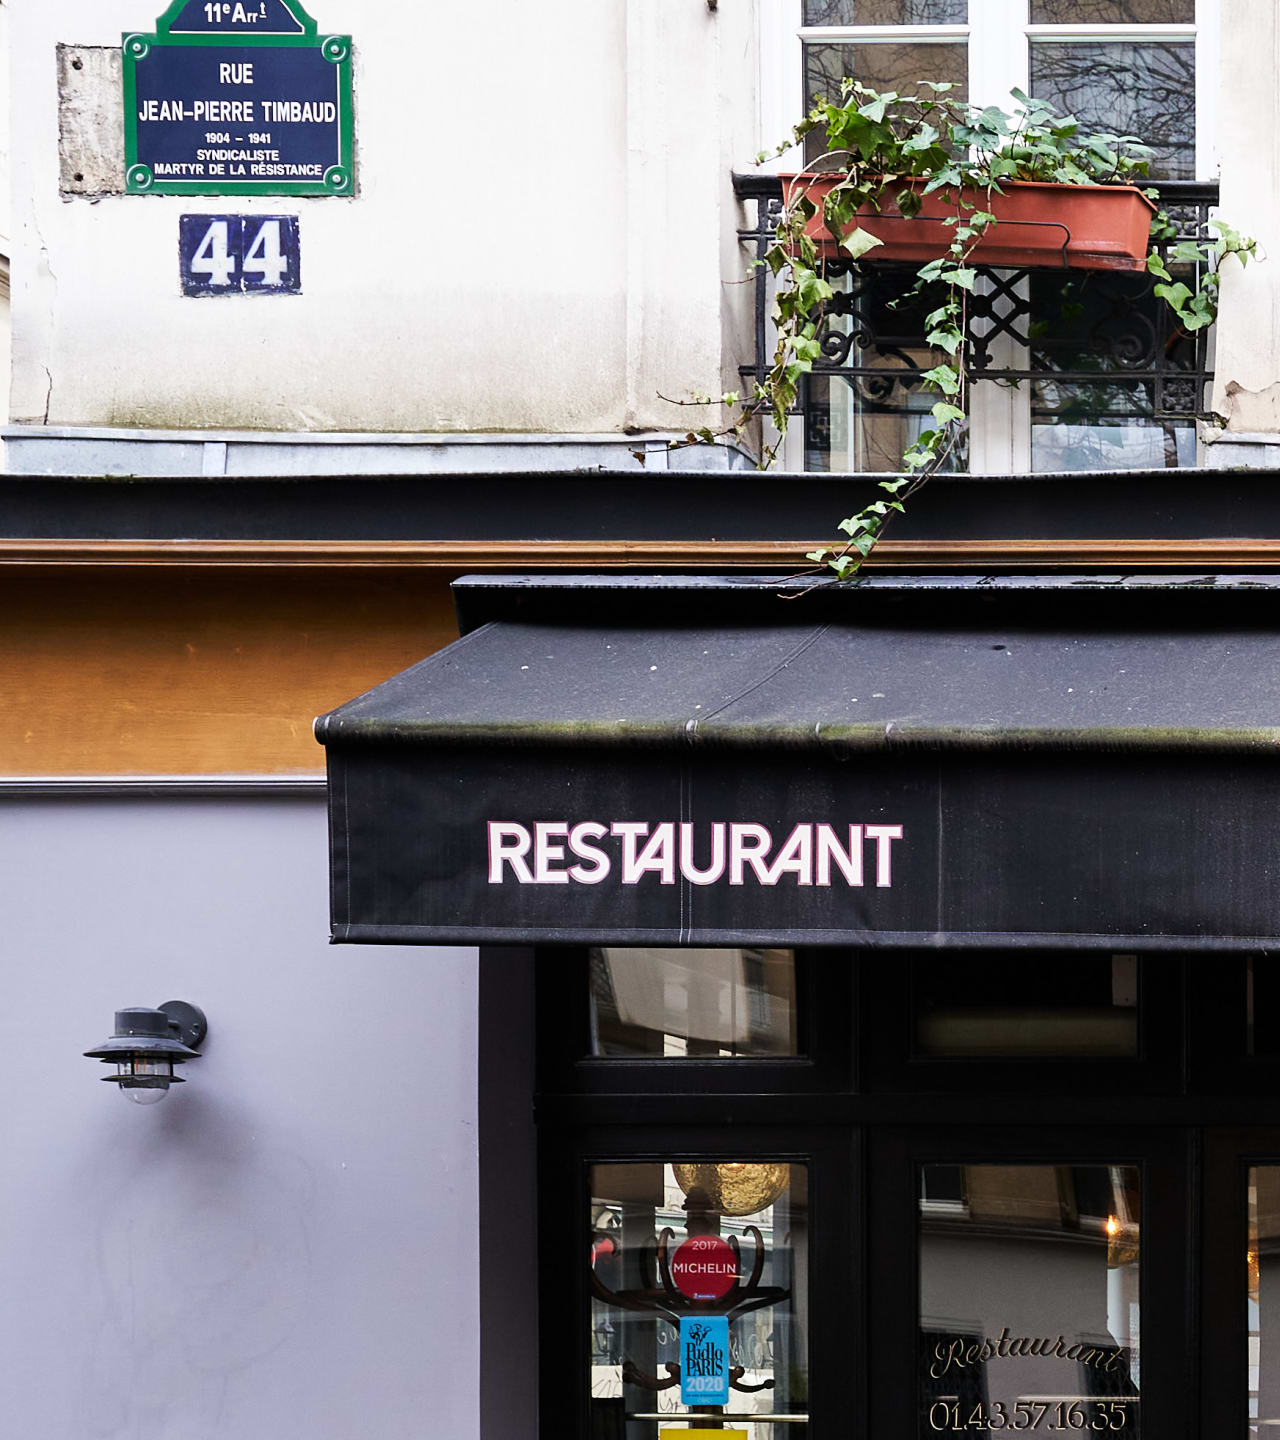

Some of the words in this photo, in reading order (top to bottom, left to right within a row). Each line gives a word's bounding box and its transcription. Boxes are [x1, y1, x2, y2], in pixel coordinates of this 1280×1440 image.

[219, 63, 254, 84] RUE
[138, 100, 254, 122] JEAN-PIERRE
[261, 101, 336, 123] TIMBAUD
[204, 133, 231, 144] 1904
[248, 133, 272, 144] 1941
[196, 149, 280, 162] SYNDICALISTE
[154, 163, 205, 175] MARTYR
[208, 164, 226, 175] DE
[229, 164, 246, 175] LA
[250, 161, 323, 176] RÉSISTANCE
[190, 219, 289, 286] 44
[486, 819, 904, 888] RESTAURANT
[691, 1240, 718, 1251] 2017
[672, 1263, 737, 1274] MICHELIN
[930, 1327, 1126, 1379] Restaurant
[685, 1359, 724, 1377] PARIS
[685, 1377, 724, 1393] 2020
